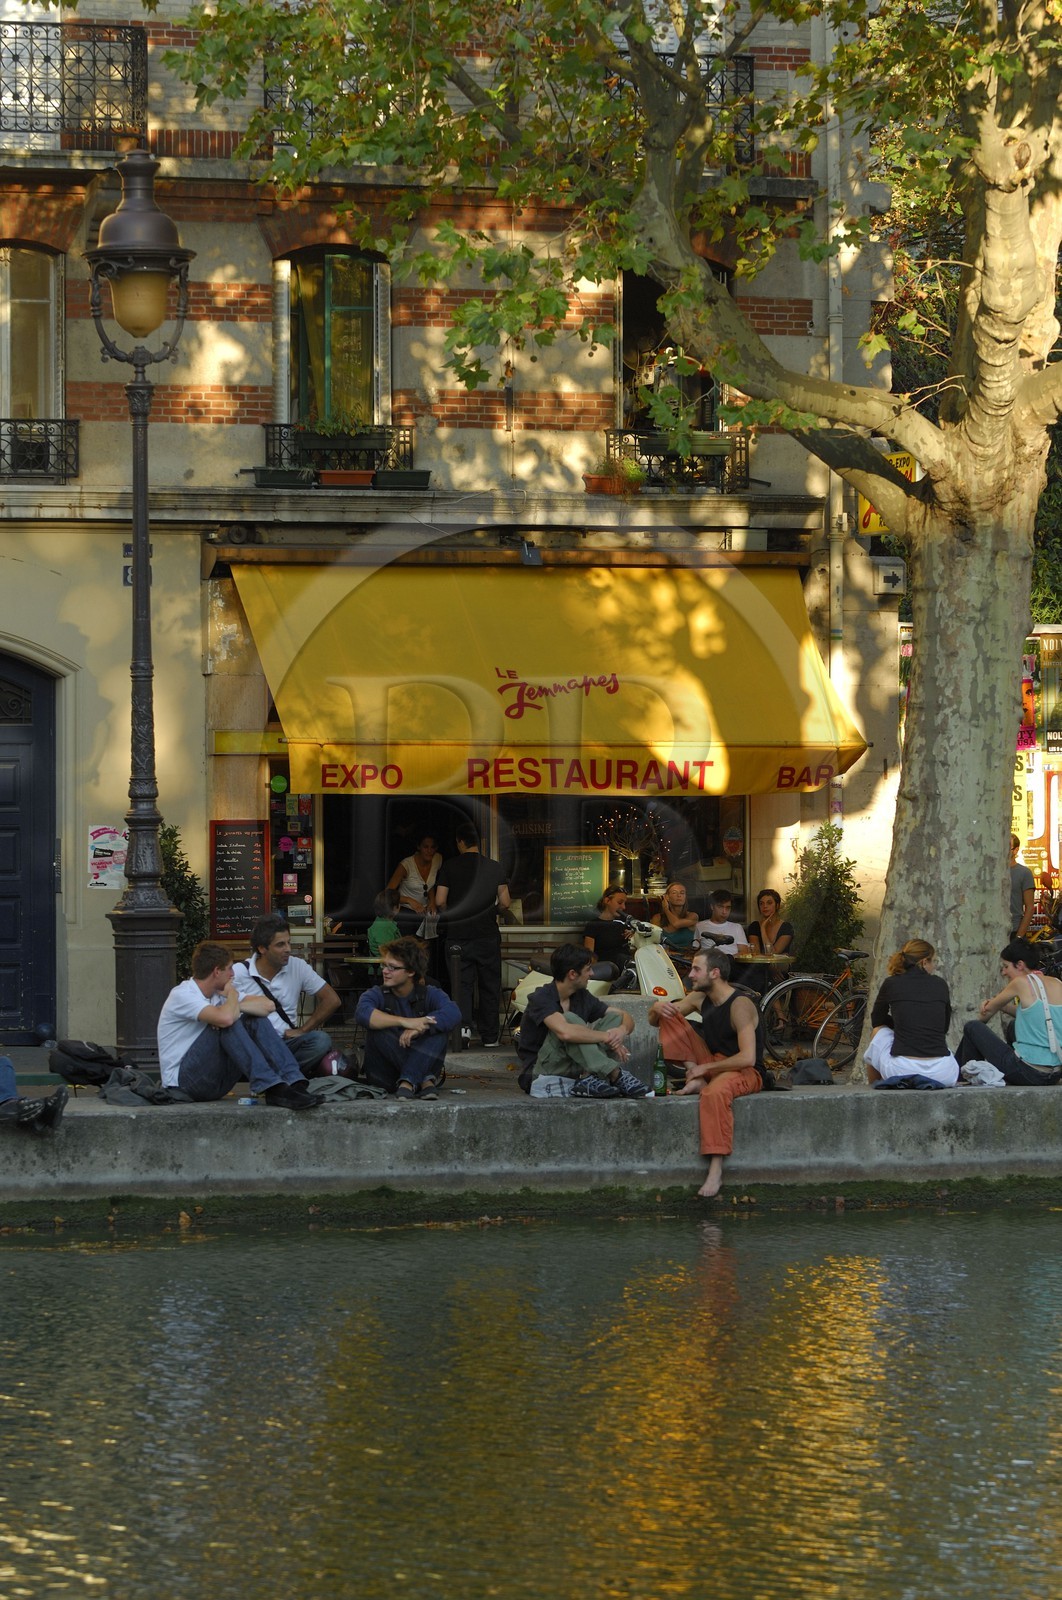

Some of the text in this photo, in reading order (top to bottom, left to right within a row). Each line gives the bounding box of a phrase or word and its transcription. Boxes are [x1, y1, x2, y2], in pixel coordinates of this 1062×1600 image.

[495, 667, 519, 679] LE
[497, 673, 619, 719] Jemmapes
[321, 758, 835, 792] EXPO RESTAURANT BAR
[512, 823, 552, 835] CUISINE
